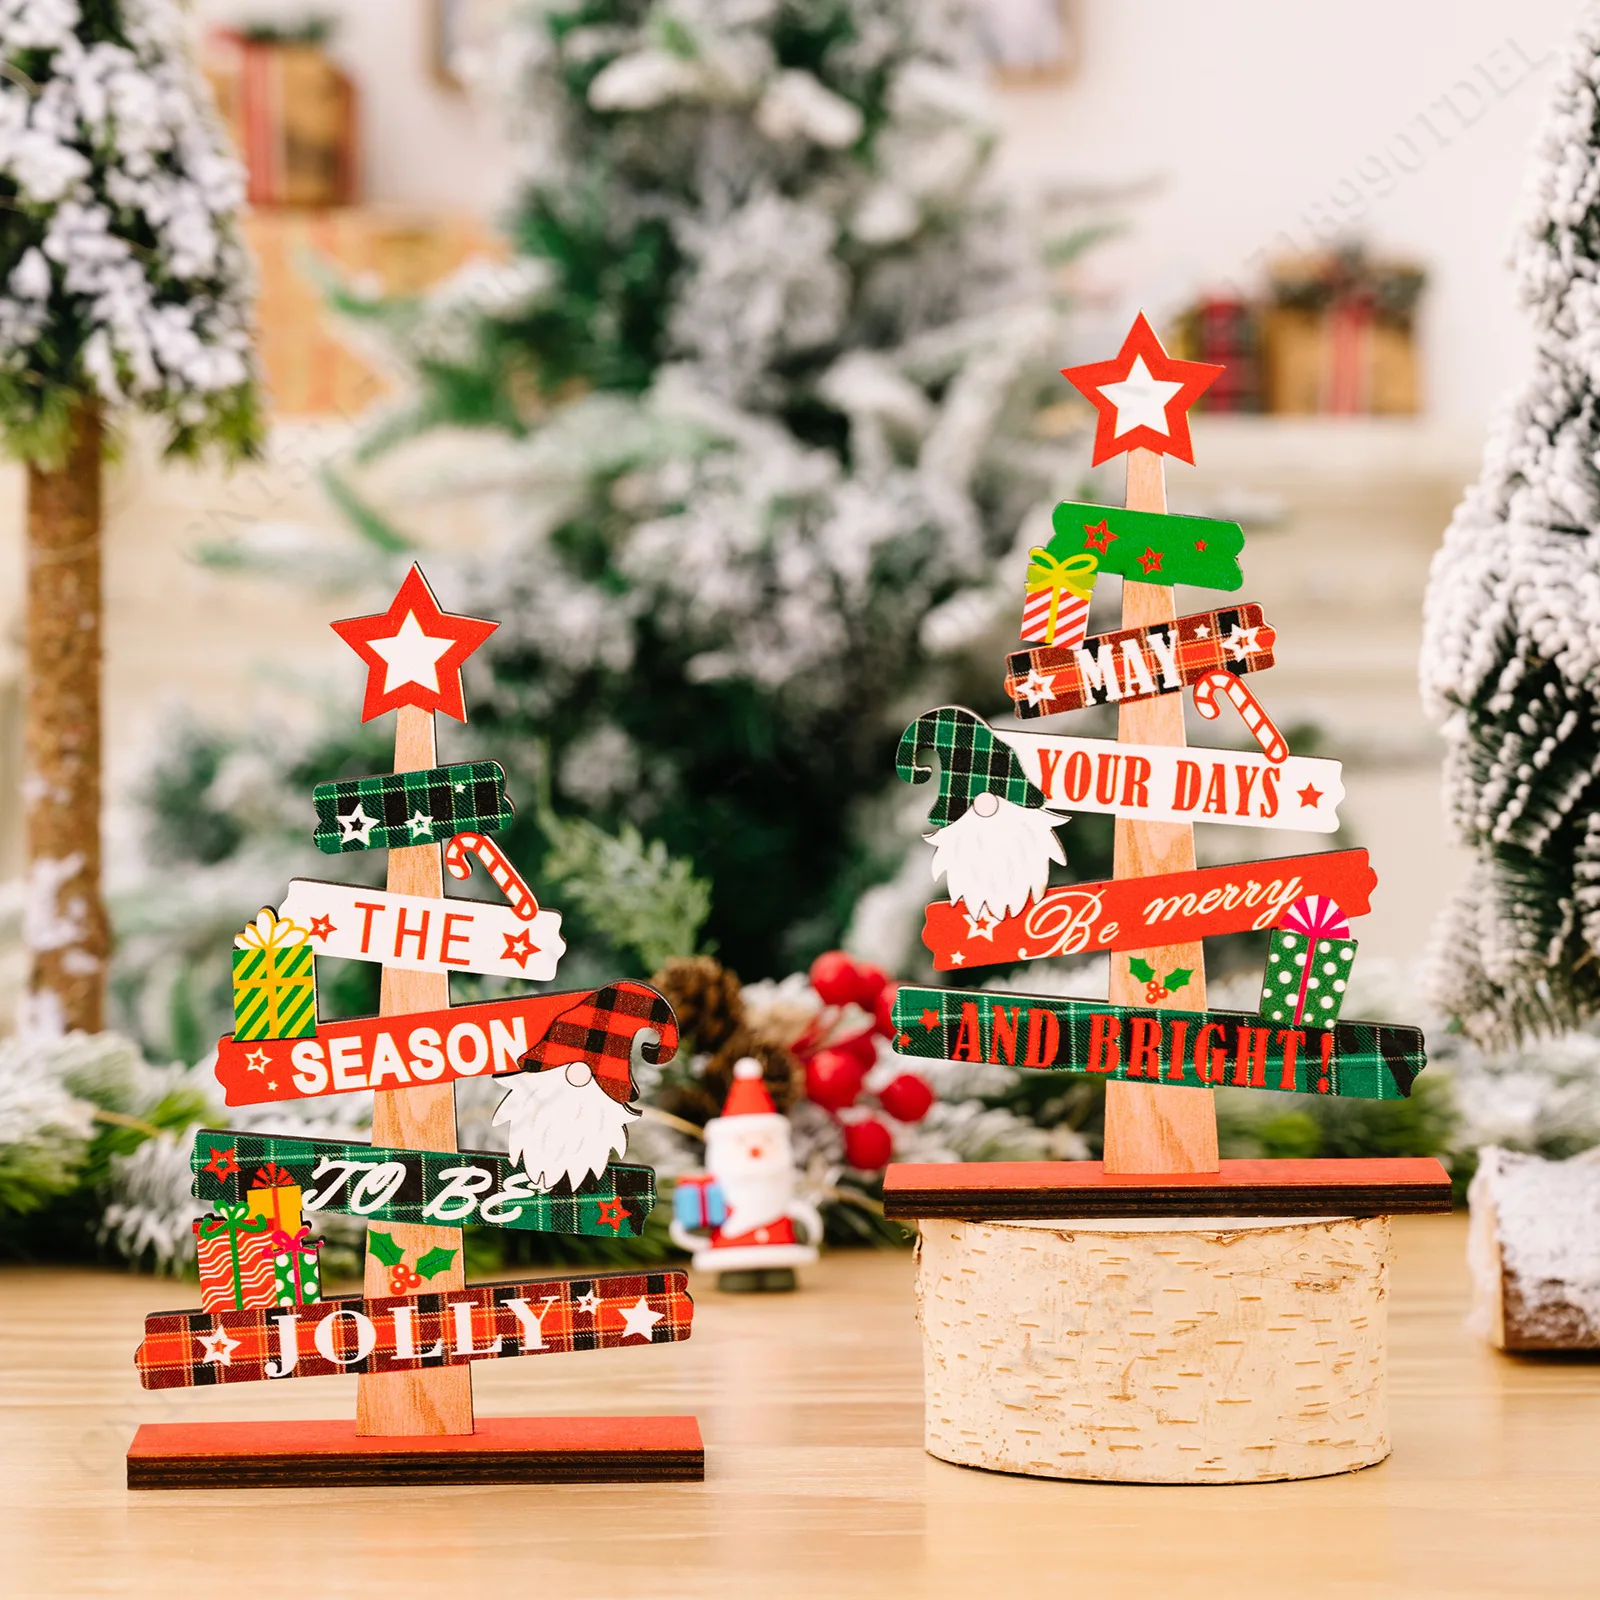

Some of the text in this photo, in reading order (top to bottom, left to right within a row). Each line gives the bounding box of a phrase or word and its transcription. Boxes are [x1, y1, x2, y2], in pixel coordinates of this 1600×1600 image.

[1077, 629, 1184, 706] MAY
[1036, 747, 1281, 819] YOUR DAYS
[353, 902, 475, 966] THE
[1016, 876, 1303, 960] Be merry
[291, 1016, 528, 1095] SEASON
[952, 1002, 1335, 1095] AND BRIGHT!
[302, 1157, 552, 1223] TO BE
[264, 1295, 561, 1378] JOLLY
